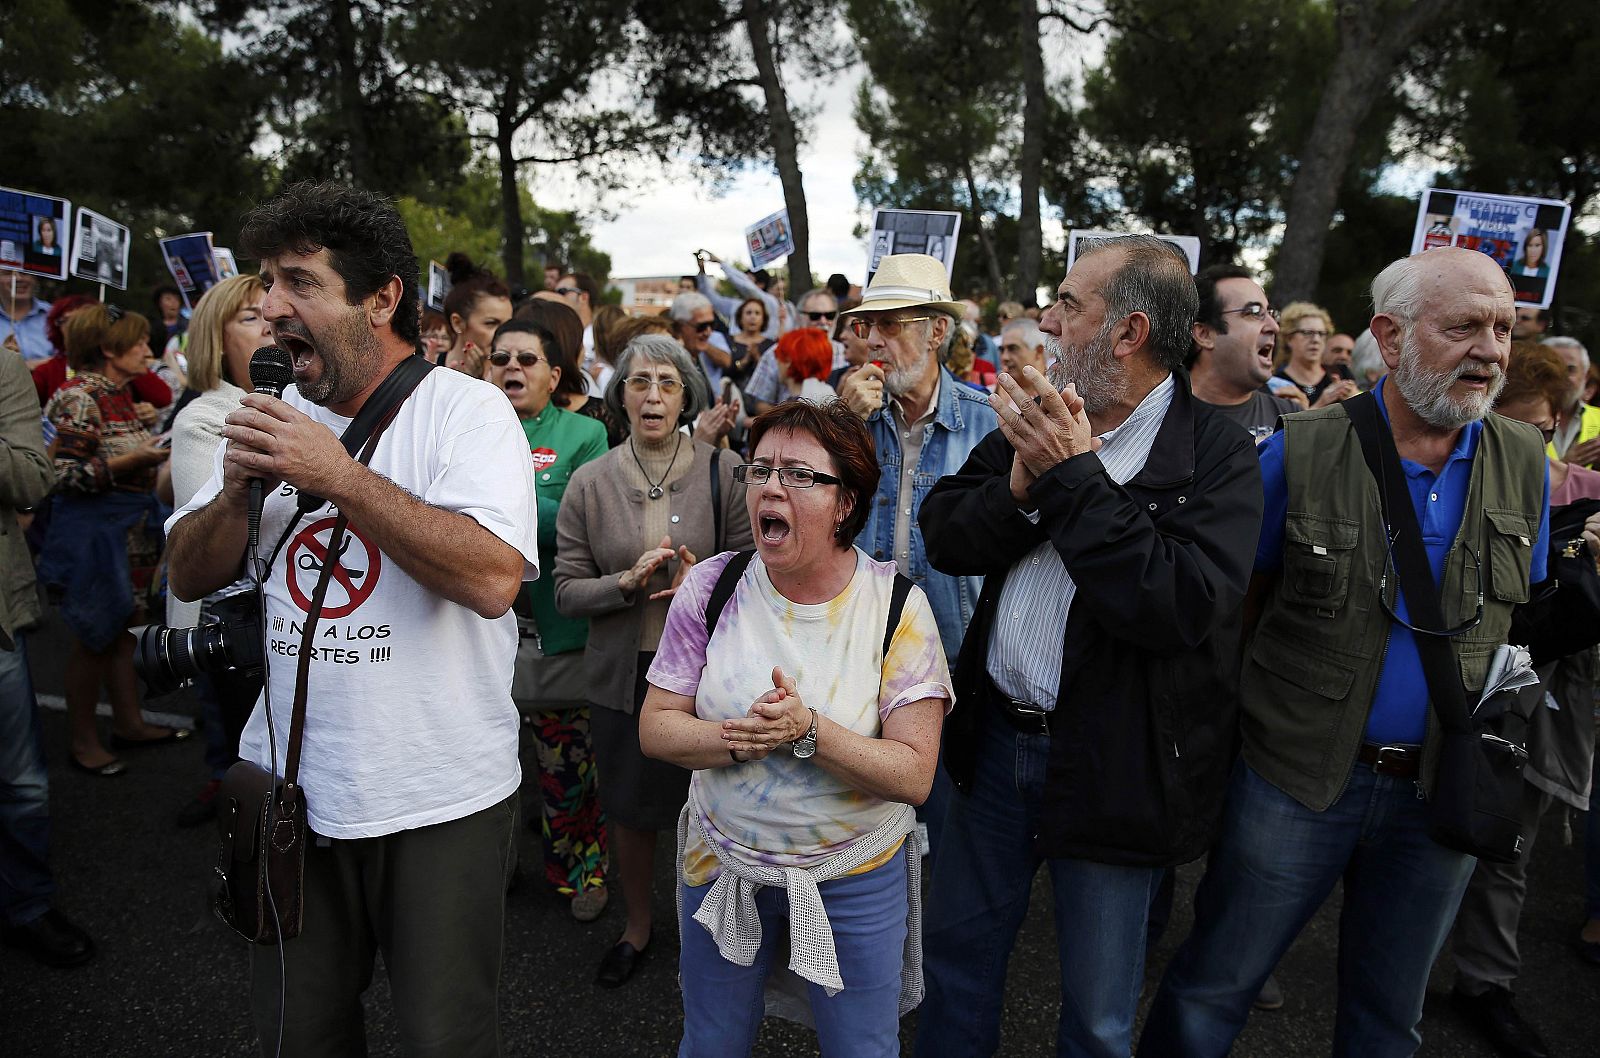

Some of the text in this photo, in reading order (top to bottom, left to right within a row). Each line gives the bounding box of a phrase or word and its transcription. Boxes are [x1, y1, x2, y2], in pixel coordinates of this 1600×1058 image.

[1458, 196, 1520, 216] HEPATITIS
[1525, 205, 1536, 219] C
[323, 625, 338, 638] A
[346, 624, 391, 640] LOS
[271, 639, 360, 664] RECRTES
